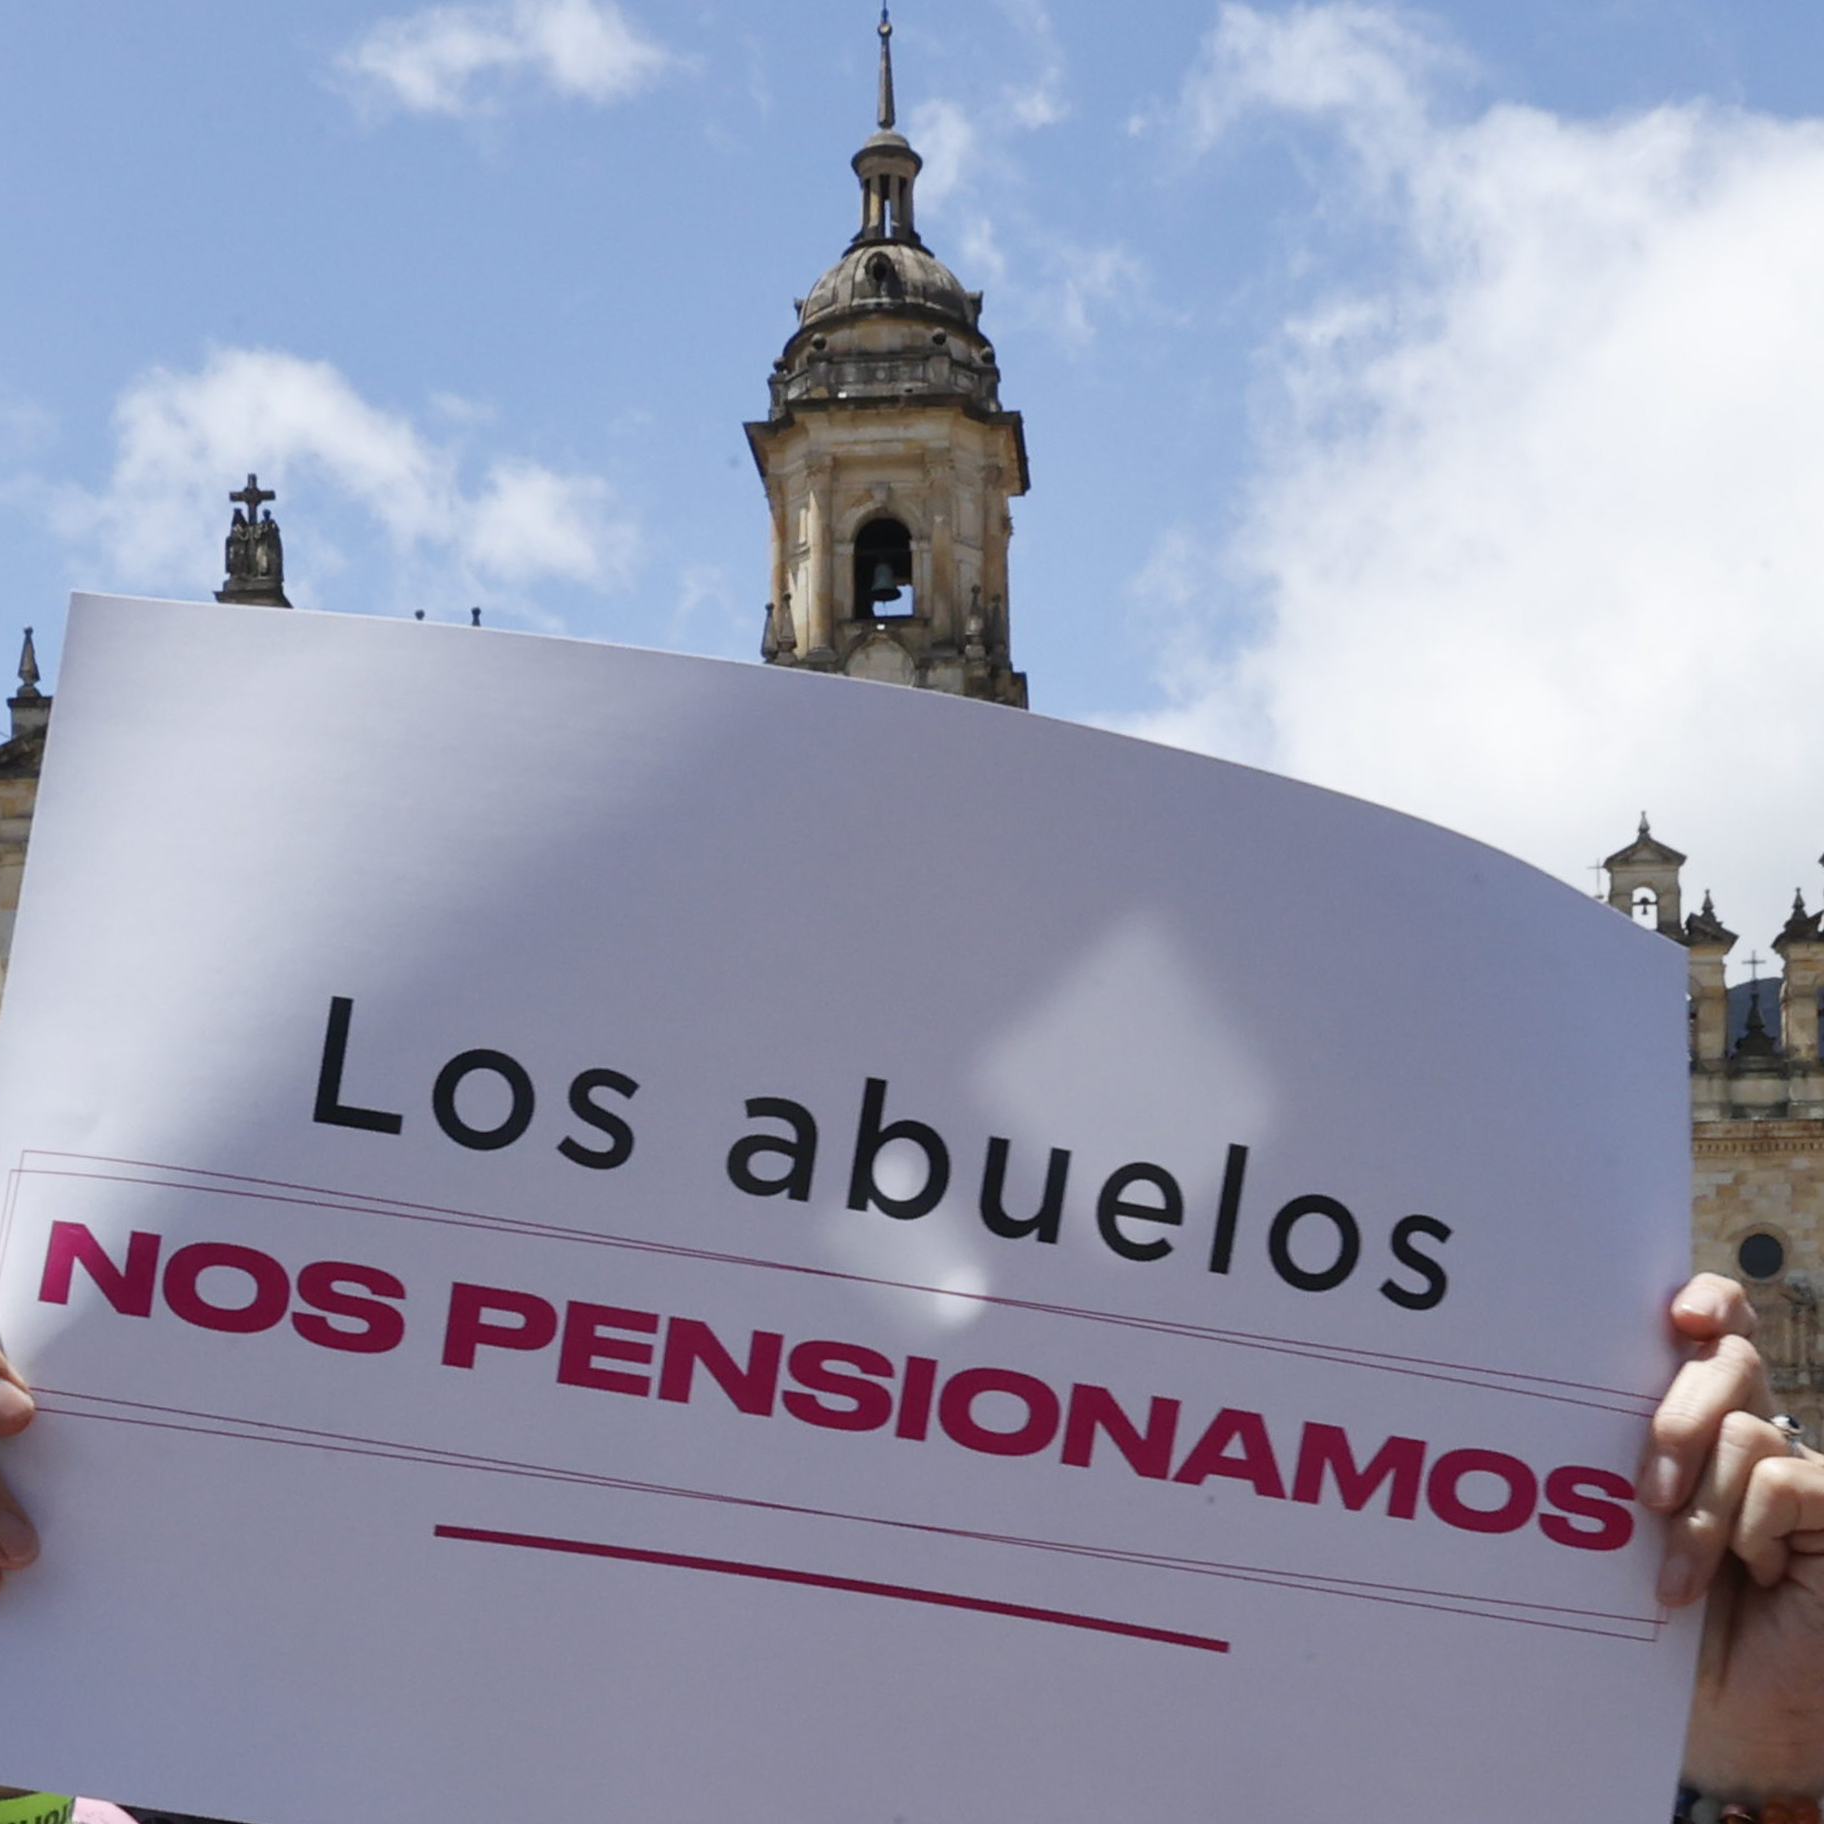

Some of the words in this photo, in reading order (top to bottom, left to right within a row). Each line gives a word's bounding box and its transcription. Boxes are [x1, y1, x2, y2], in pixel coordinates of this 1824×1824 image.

[313, 997, 640, 1171] Los
[727, 1077, 1453, 1311] abuelos
[40, 1222, 406, 1354] NOS
[442, 1283, 1640, 1552] PENSIONAMOS
